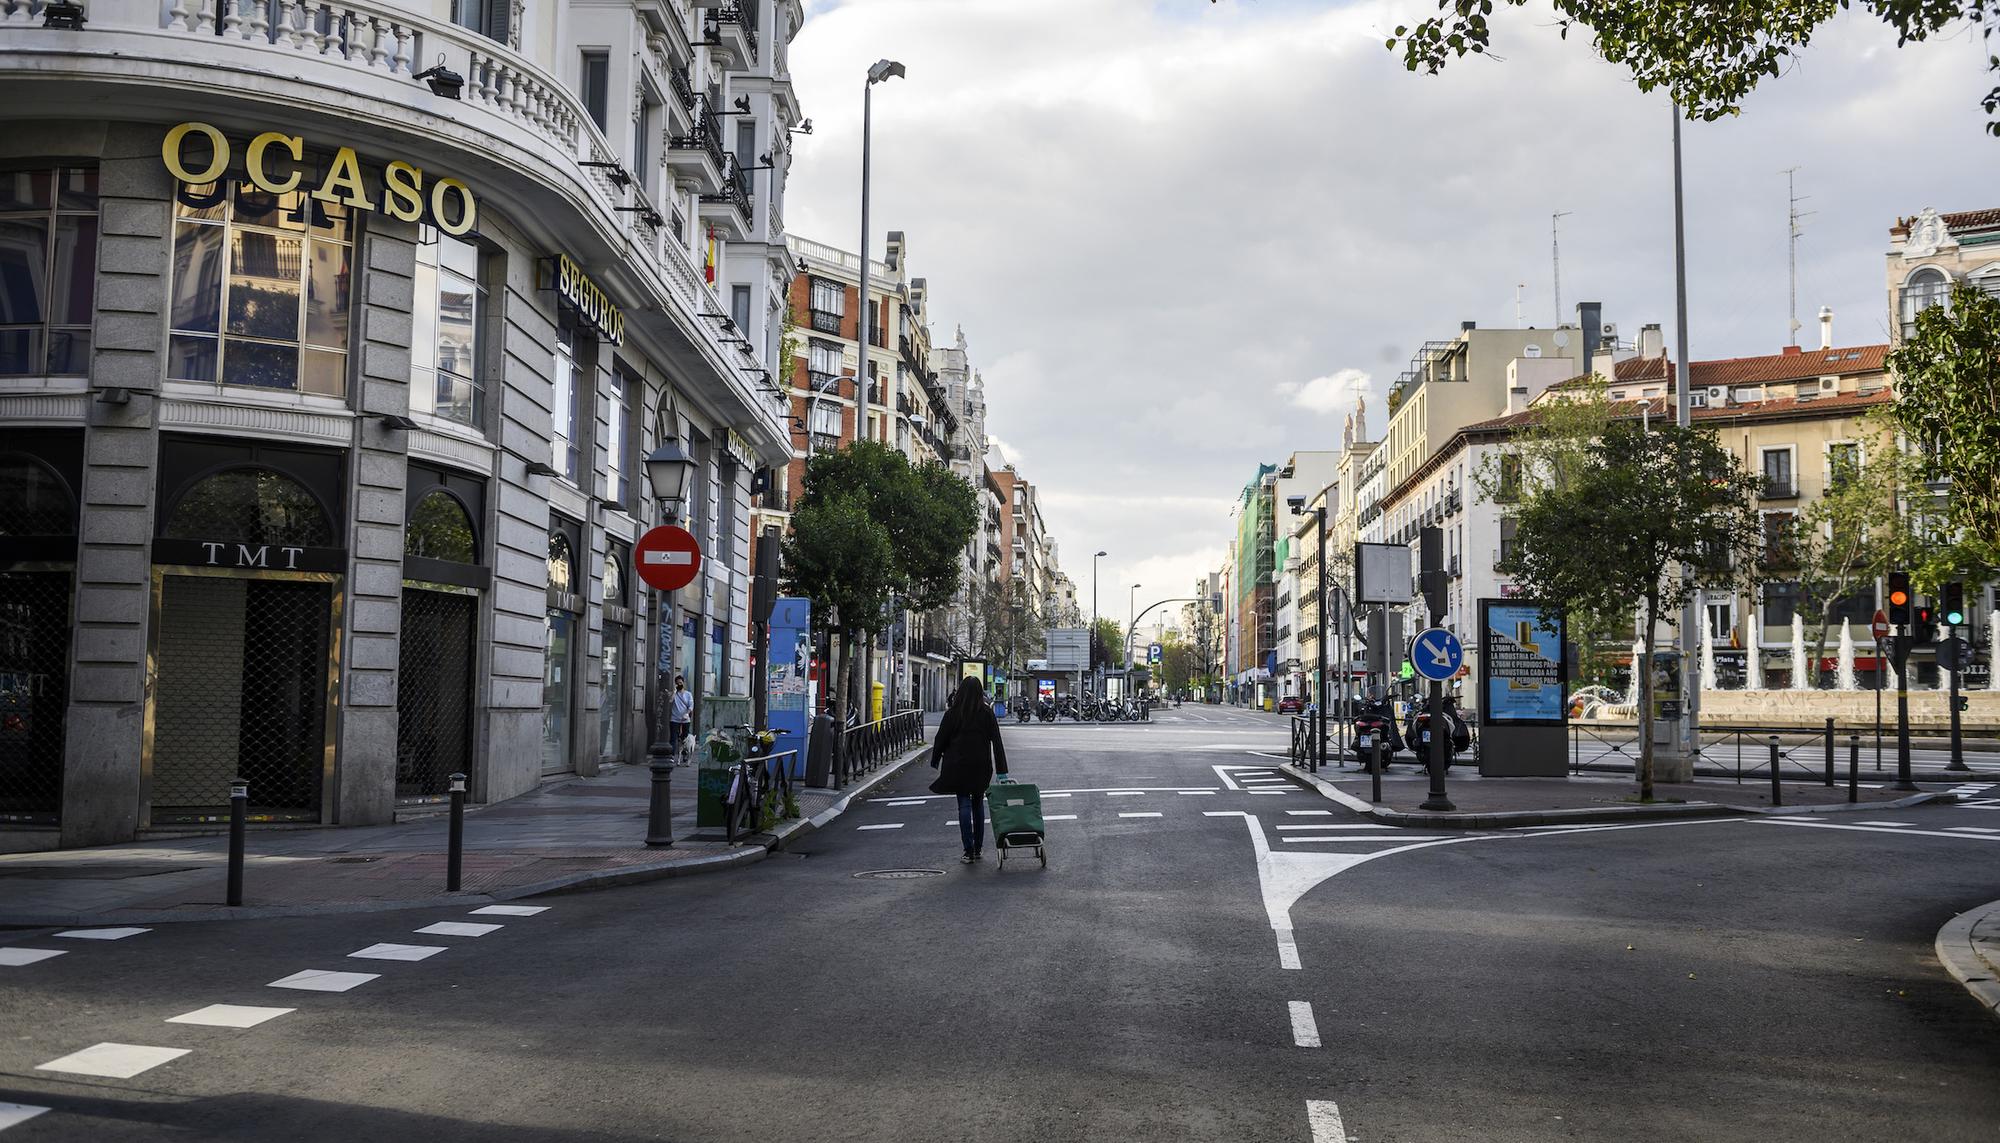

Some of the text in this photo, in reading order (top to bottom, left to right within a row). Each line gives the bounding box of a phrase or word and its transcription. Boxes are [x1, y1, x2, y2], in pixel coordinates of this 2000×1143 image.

[162, 122, 476, 235] OCASO
[560, 254, 625, 347] SEGUROS
[202, 542, 303, 569] TMT
[557, 591, 575, 610] TMT
[1150, 645, 1161, 659] P
